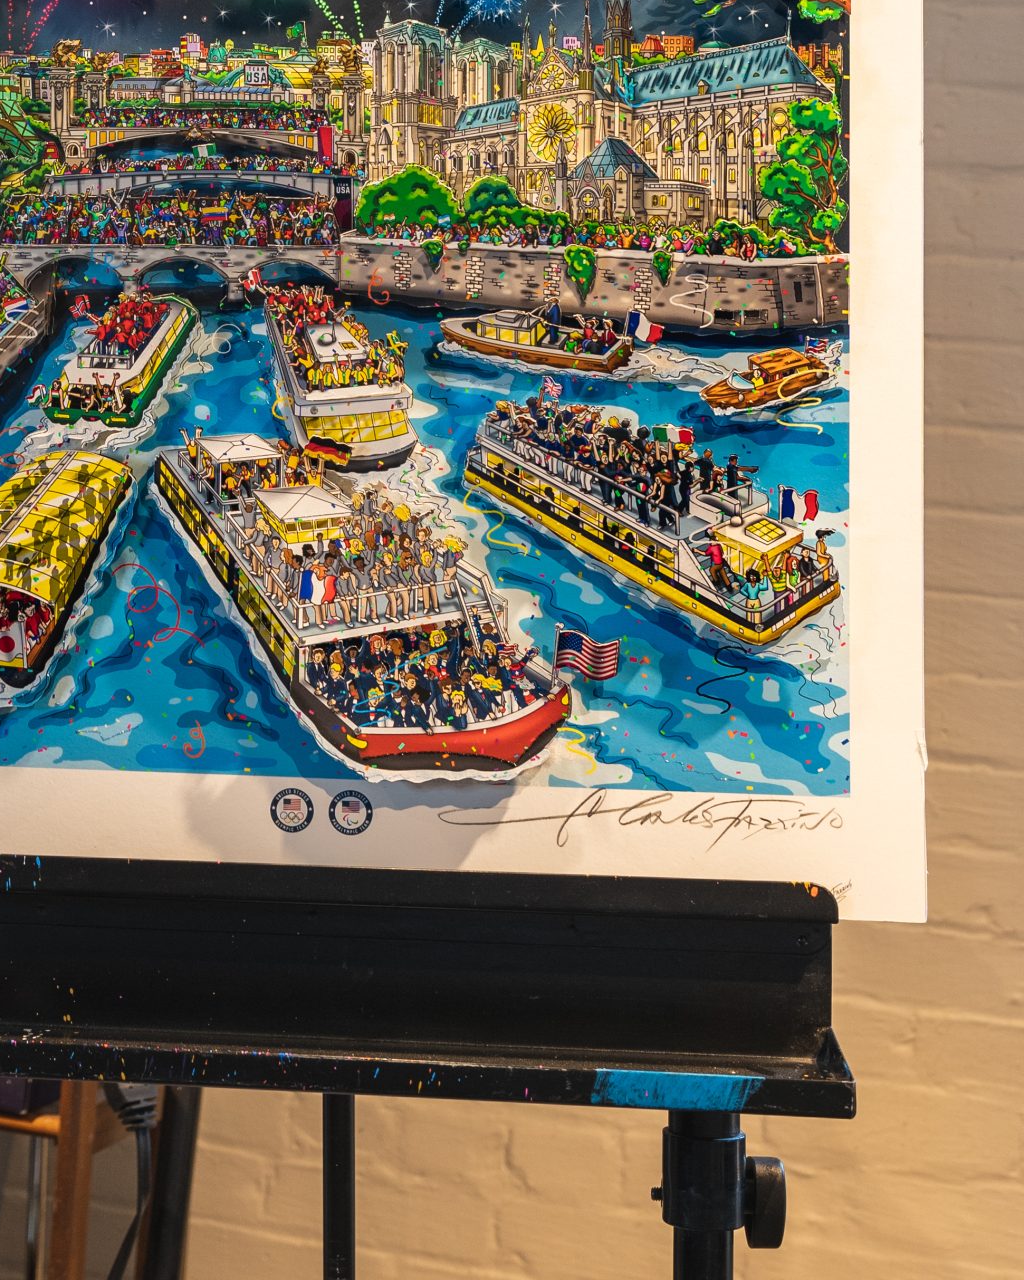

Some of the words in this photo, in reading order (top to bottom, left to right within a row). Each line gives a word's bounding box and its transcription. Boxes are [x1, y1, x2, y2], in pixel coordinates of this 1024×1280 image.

[246, 72, 267, 83] USA
[336, 186, 350, 194] USA
[275, 789, 292, 800] UNITED
[293, 789, 309, 801] STATES
